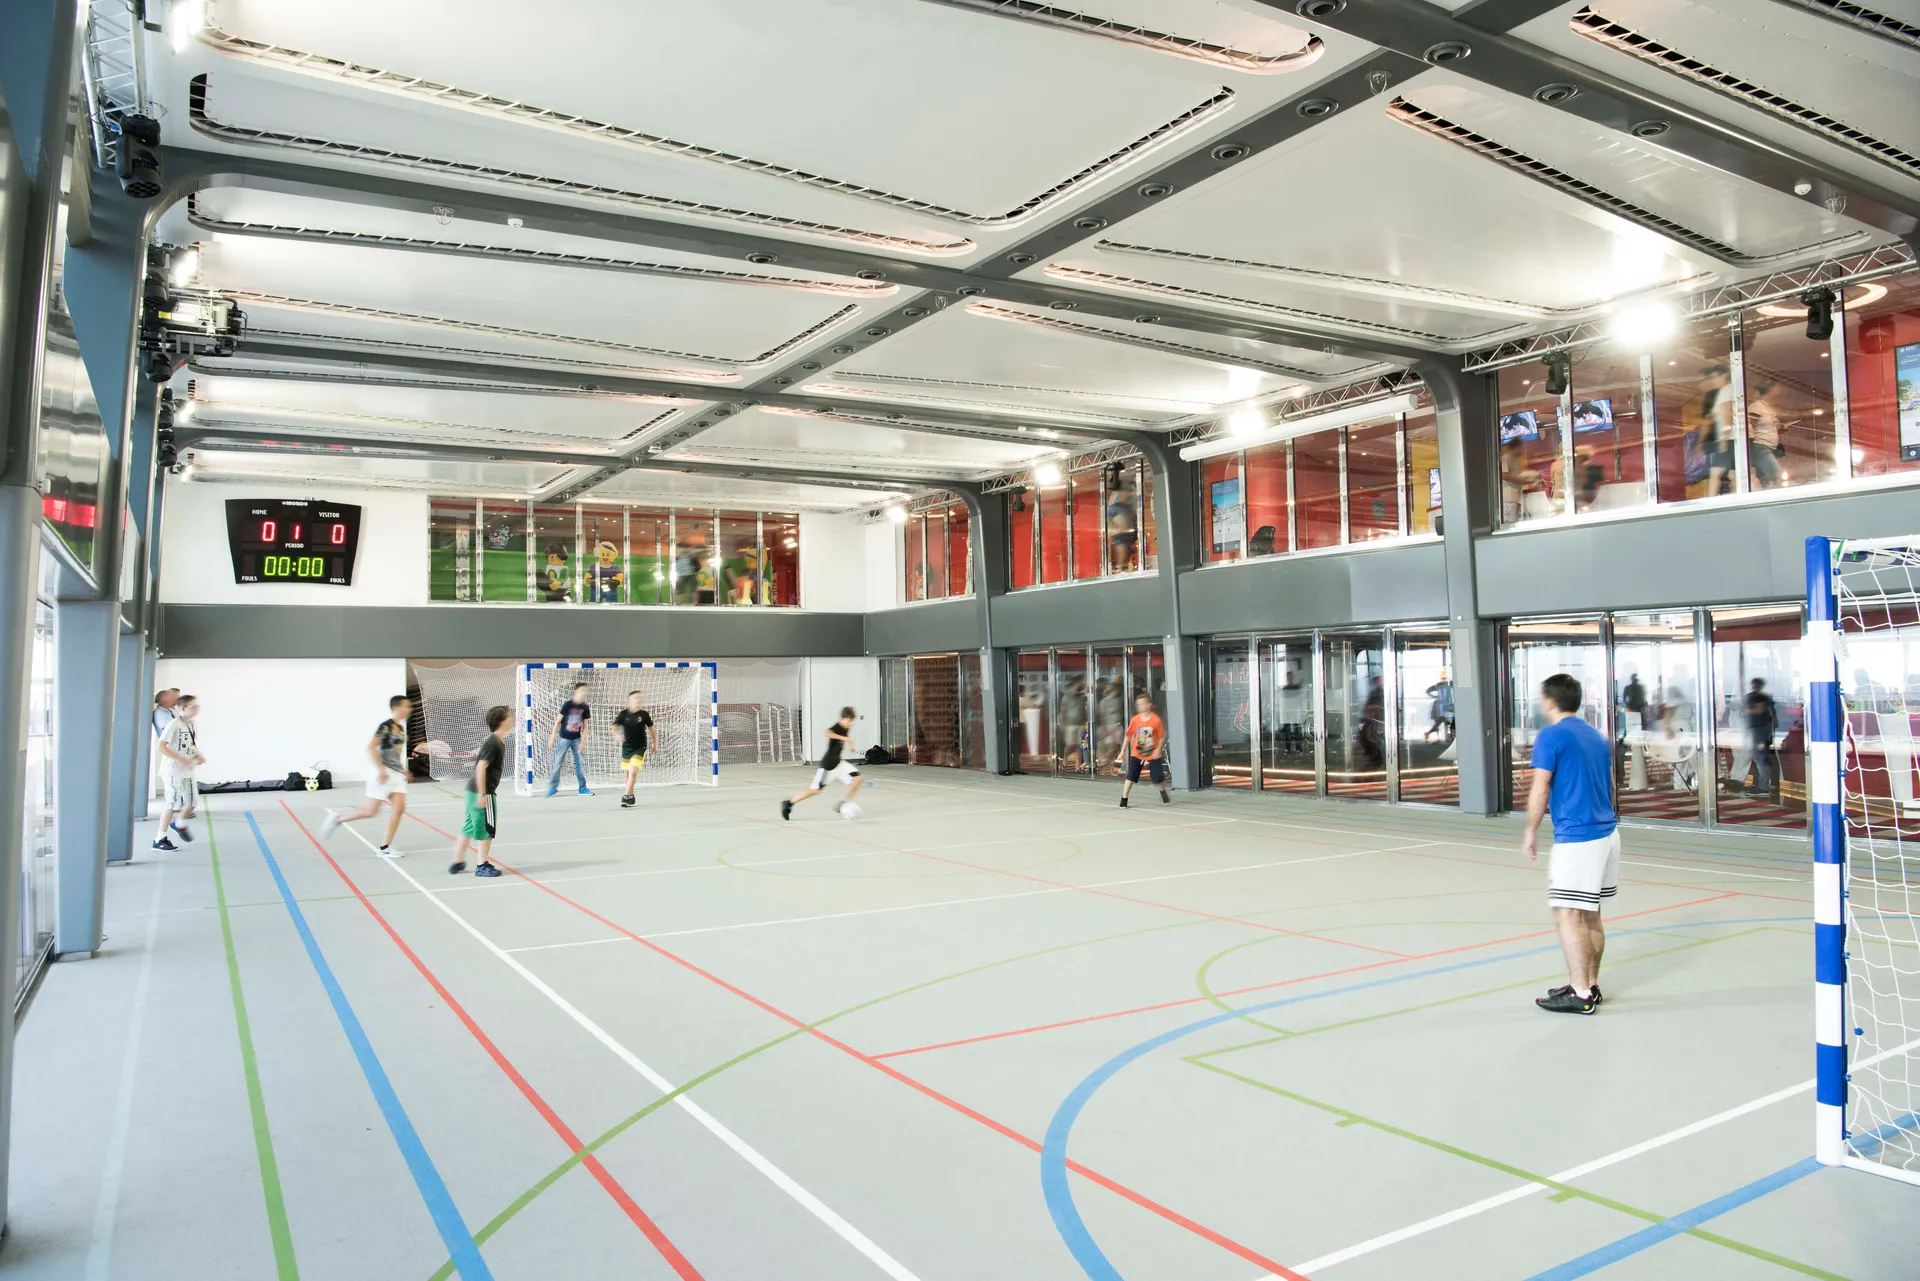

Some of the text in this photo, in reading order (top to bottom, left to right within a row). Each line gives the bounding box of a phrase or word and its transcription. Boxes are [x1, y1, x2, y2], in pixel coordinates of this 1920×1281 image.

[262, 521, 275, 541] 0
[294, 525, 300, 540] 1
[332, 524, 344, 544] 0
[264, 556, 323, 577] 00:00
